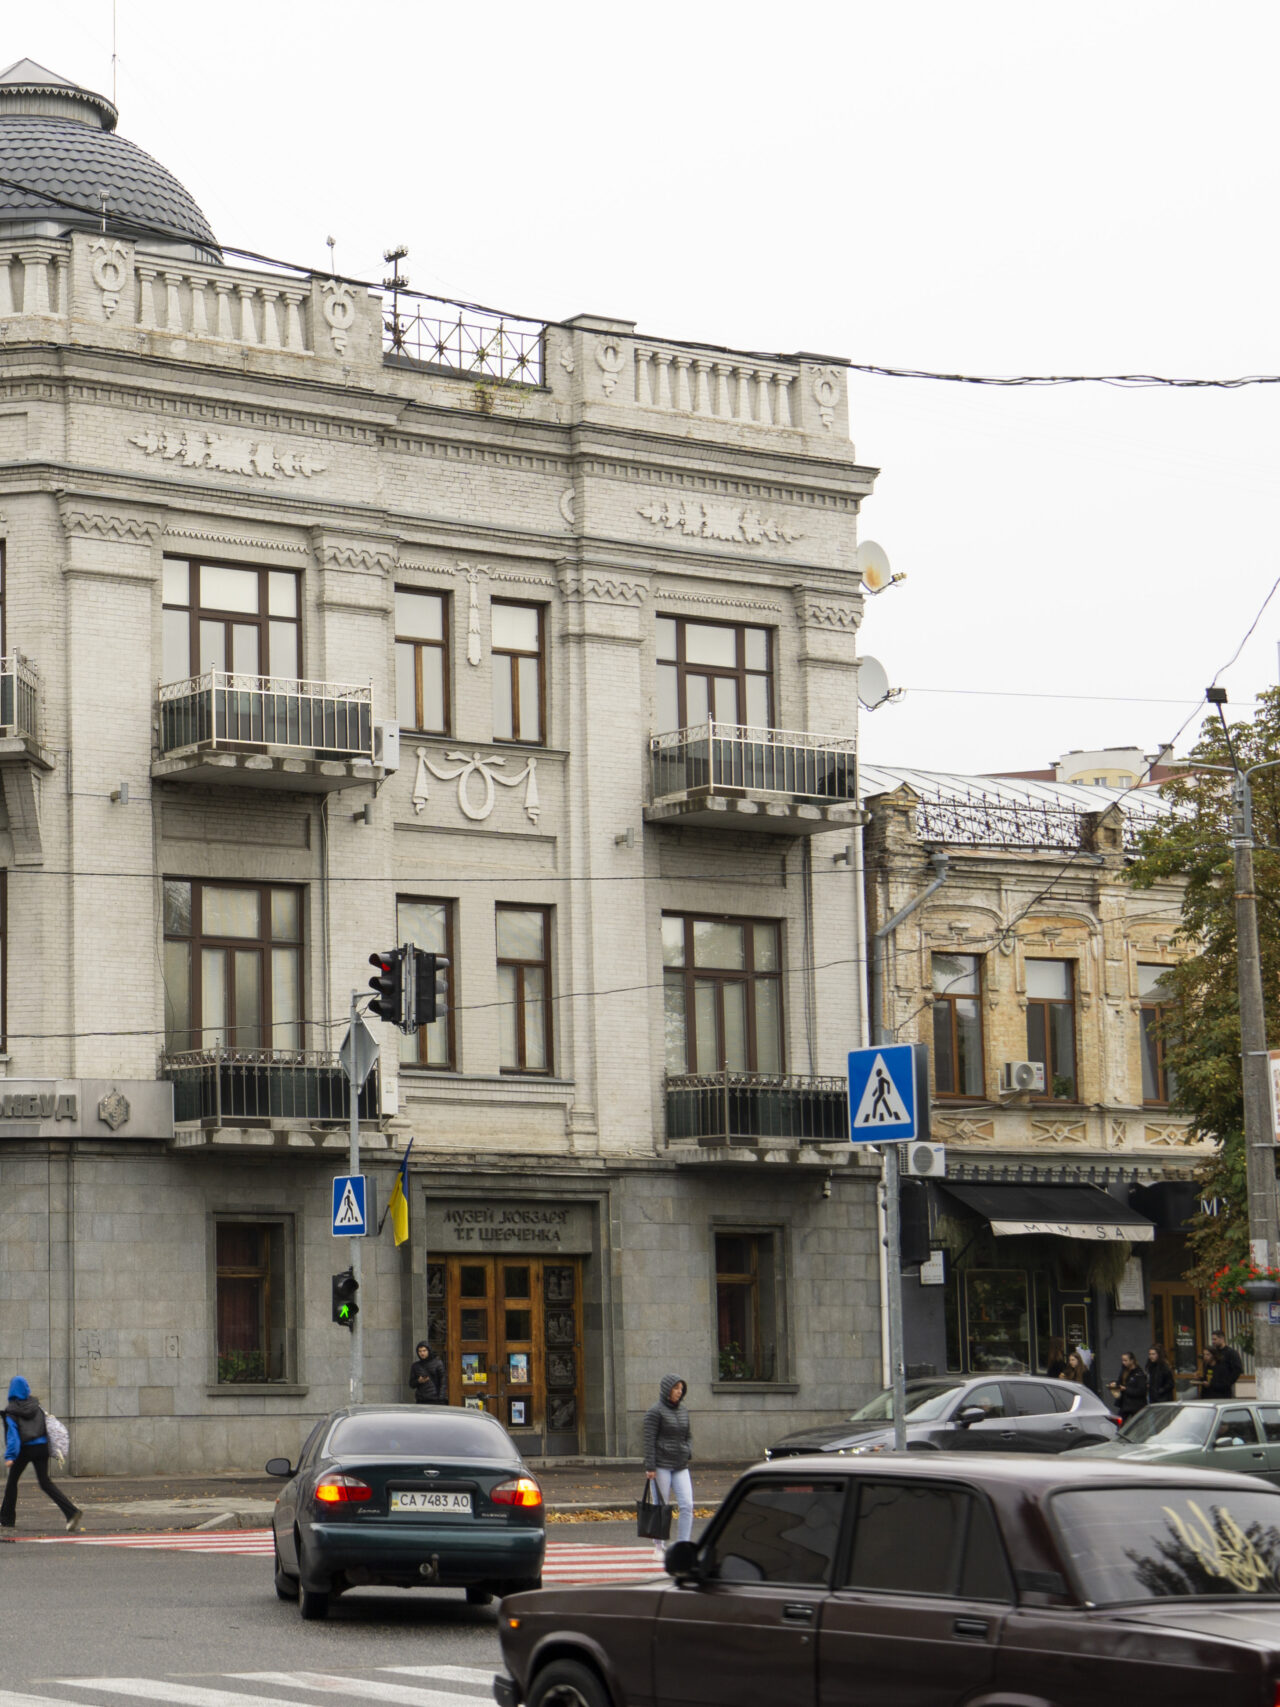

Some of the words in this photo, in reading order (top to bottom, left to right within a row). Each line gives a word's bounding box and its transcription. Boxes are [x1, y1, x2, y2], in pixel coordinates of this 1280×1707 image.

[443, 1207, 494, 1226] МУЗЕЙ
[478, 1227, 561, 1242] ШЕВЧЕНКА
[400, 1494, 417, 1507] CA
[422, 1494, 449, 1507] 7483
[453, 1495, 469, 1508] AO
